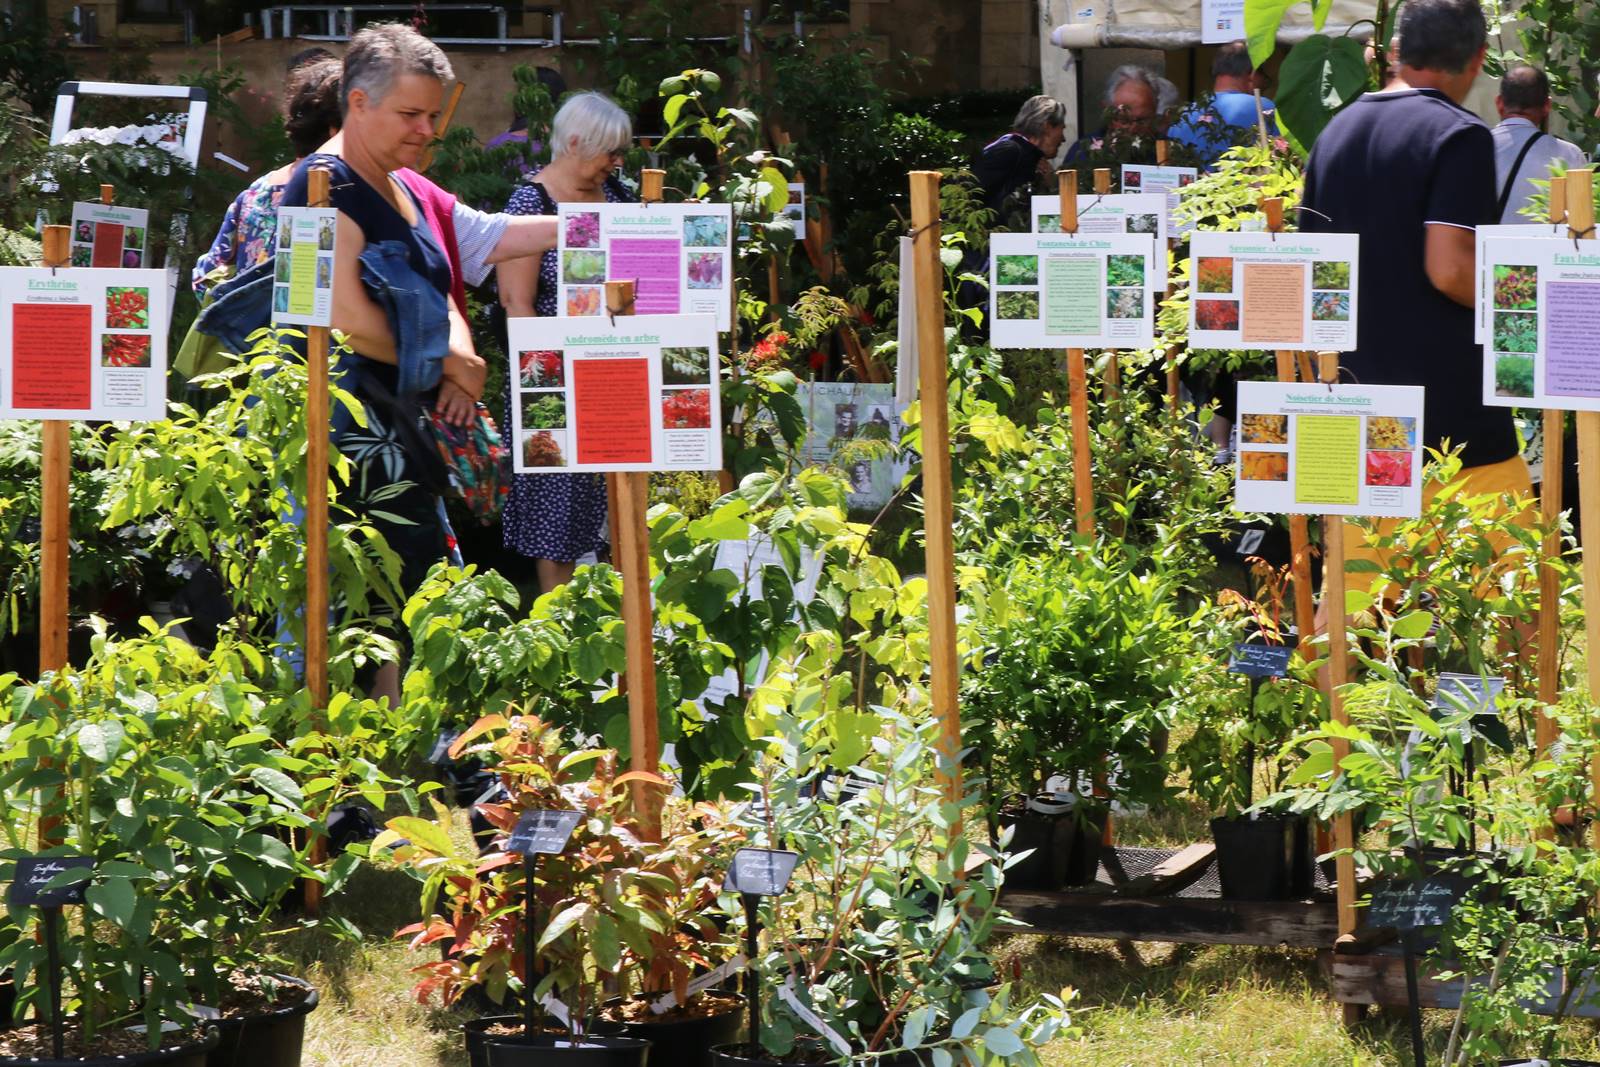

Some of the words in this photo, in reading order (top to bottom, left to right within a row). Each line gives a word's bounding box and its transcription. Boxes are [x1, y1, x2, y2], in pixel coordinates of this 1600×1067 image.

[1078, 239, 1087, 248] de
[1554, 253, 1576, 263] Faux
[28, 278, 78, 290] Erythrine
[565, 334, 617, 345] Andromède
[620, 335, 631, 344] en
[634, 333, 661, 344] arbre
[1286, 393, 1322, 403] Noisetier
[1325, 394, 1335, 403] de
